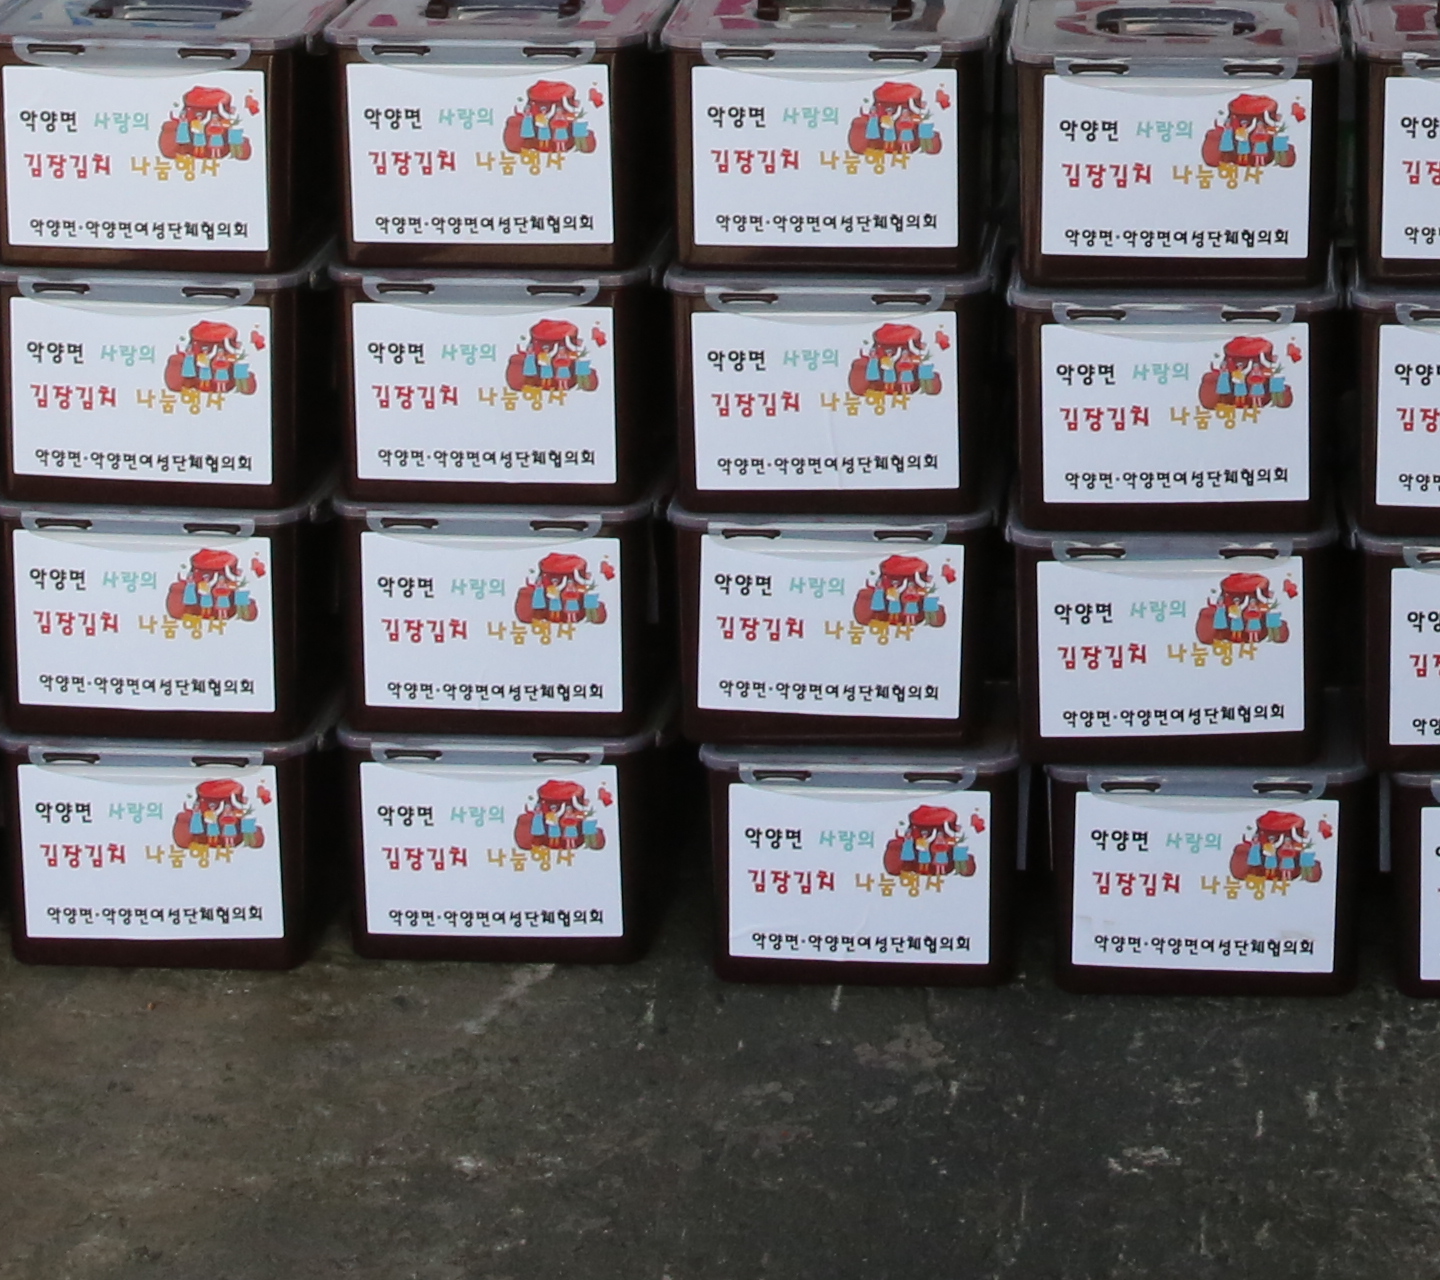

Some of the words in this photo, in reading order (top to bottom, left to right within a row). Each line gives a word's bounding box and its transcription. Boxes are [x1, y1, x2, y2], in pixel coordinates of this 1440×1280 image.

[19, 110, 78, 133] 악양면
[93, 108, 152, 132] 사랑의
[706, 106, 766, 129] 악양면
[782, 104, 842, 127] 사랑의
[23, 153, 111, 180] 김장김치
[130, 152, 221, 180] 나눔행사
[710, 148, 799, 175] 김장김치
[818, 146, 911, 174] 나눔행사
[367, 342, 425, 365] 악양면
[440, 341, 499, 364] 사랑의
[1055, 363, 1116, 387] 악양면
[1131, 359, 1192, 384] 사랑의
[371, 384, 458, 410] 김장김치
[477, 383, 568, 410] 나눔행사
[1059, 404, 1149, 433] 김장김치
[1169, 400, 1262, 430] 나눔행사
[29, 568, 87, 592] 악양면
[101, 569, 160, 591] 사랑의
[713, 573, 773, 597] 악양면
[788, 574, 848, 597] 사랑의
[33, 610, 119, 637] 김장김치
[138, 612, 227, 638] 나눔행사
[716, 615, 804, 642] 김장김치
[823, 618, 915, 644] 나눔행사
[376, 805, 435, 828] 악양면
[449, 802, 507, 825] 사랑의
[1090, 829, 1149, 852] 악양면
[1164, 830, 1225, 852] 사랑의
[381, 846, 468, 872] 김장김치
[487, 843, 575, 871] 나눔행사
[1092, 871, 1181, 897] 김장김치
[1198, 873, 1291, 899] 나눔행사
